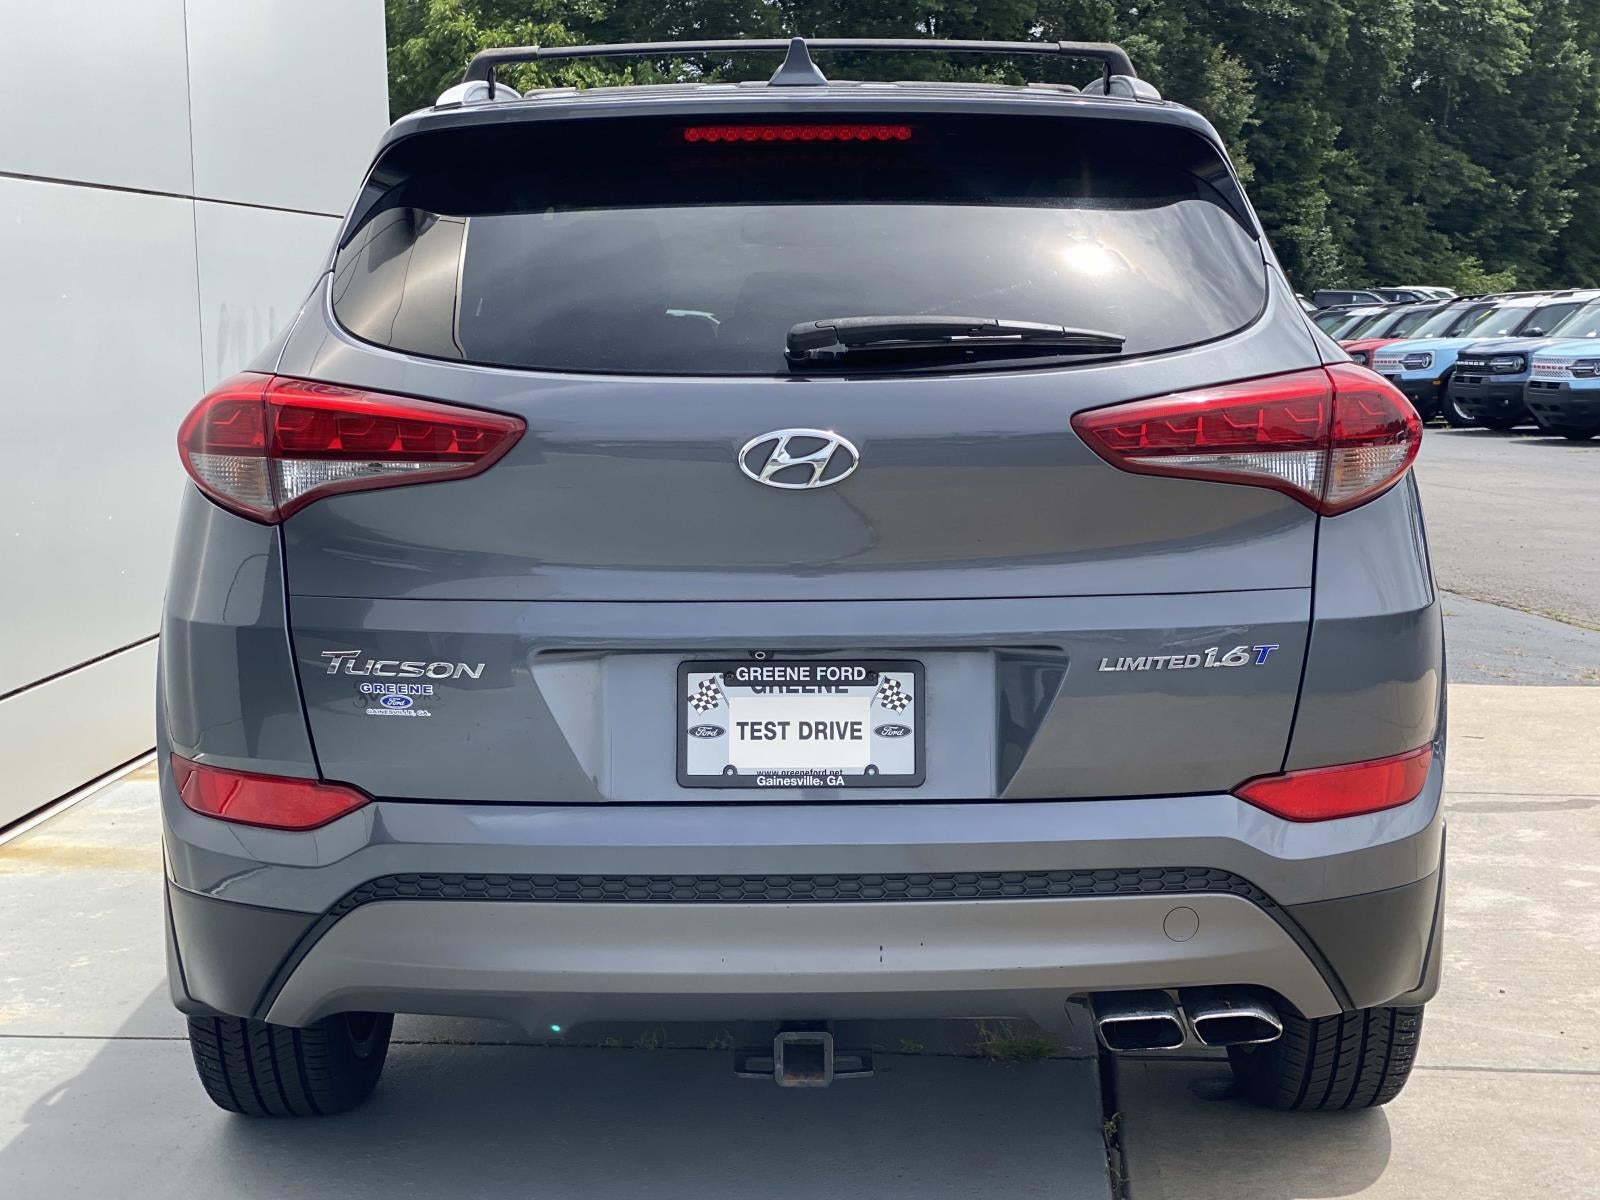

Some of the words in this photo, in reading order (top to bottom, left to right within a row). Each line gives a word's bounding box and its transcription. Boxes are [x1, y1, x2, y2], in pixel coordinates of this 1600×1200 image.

[1098, 654, 1200, 672] LIMITED
[736, 666, 811, 681] GREENE
[816, 666, 867, 681] FORD
[360, 682, 434, 695] GREENE
[736, 721, 791, 741] TEST
[798, 721, 863, 741] DRIVE
[756, 775, 824, 786] Gainesville,
[826, 775, 845, 786] GA
